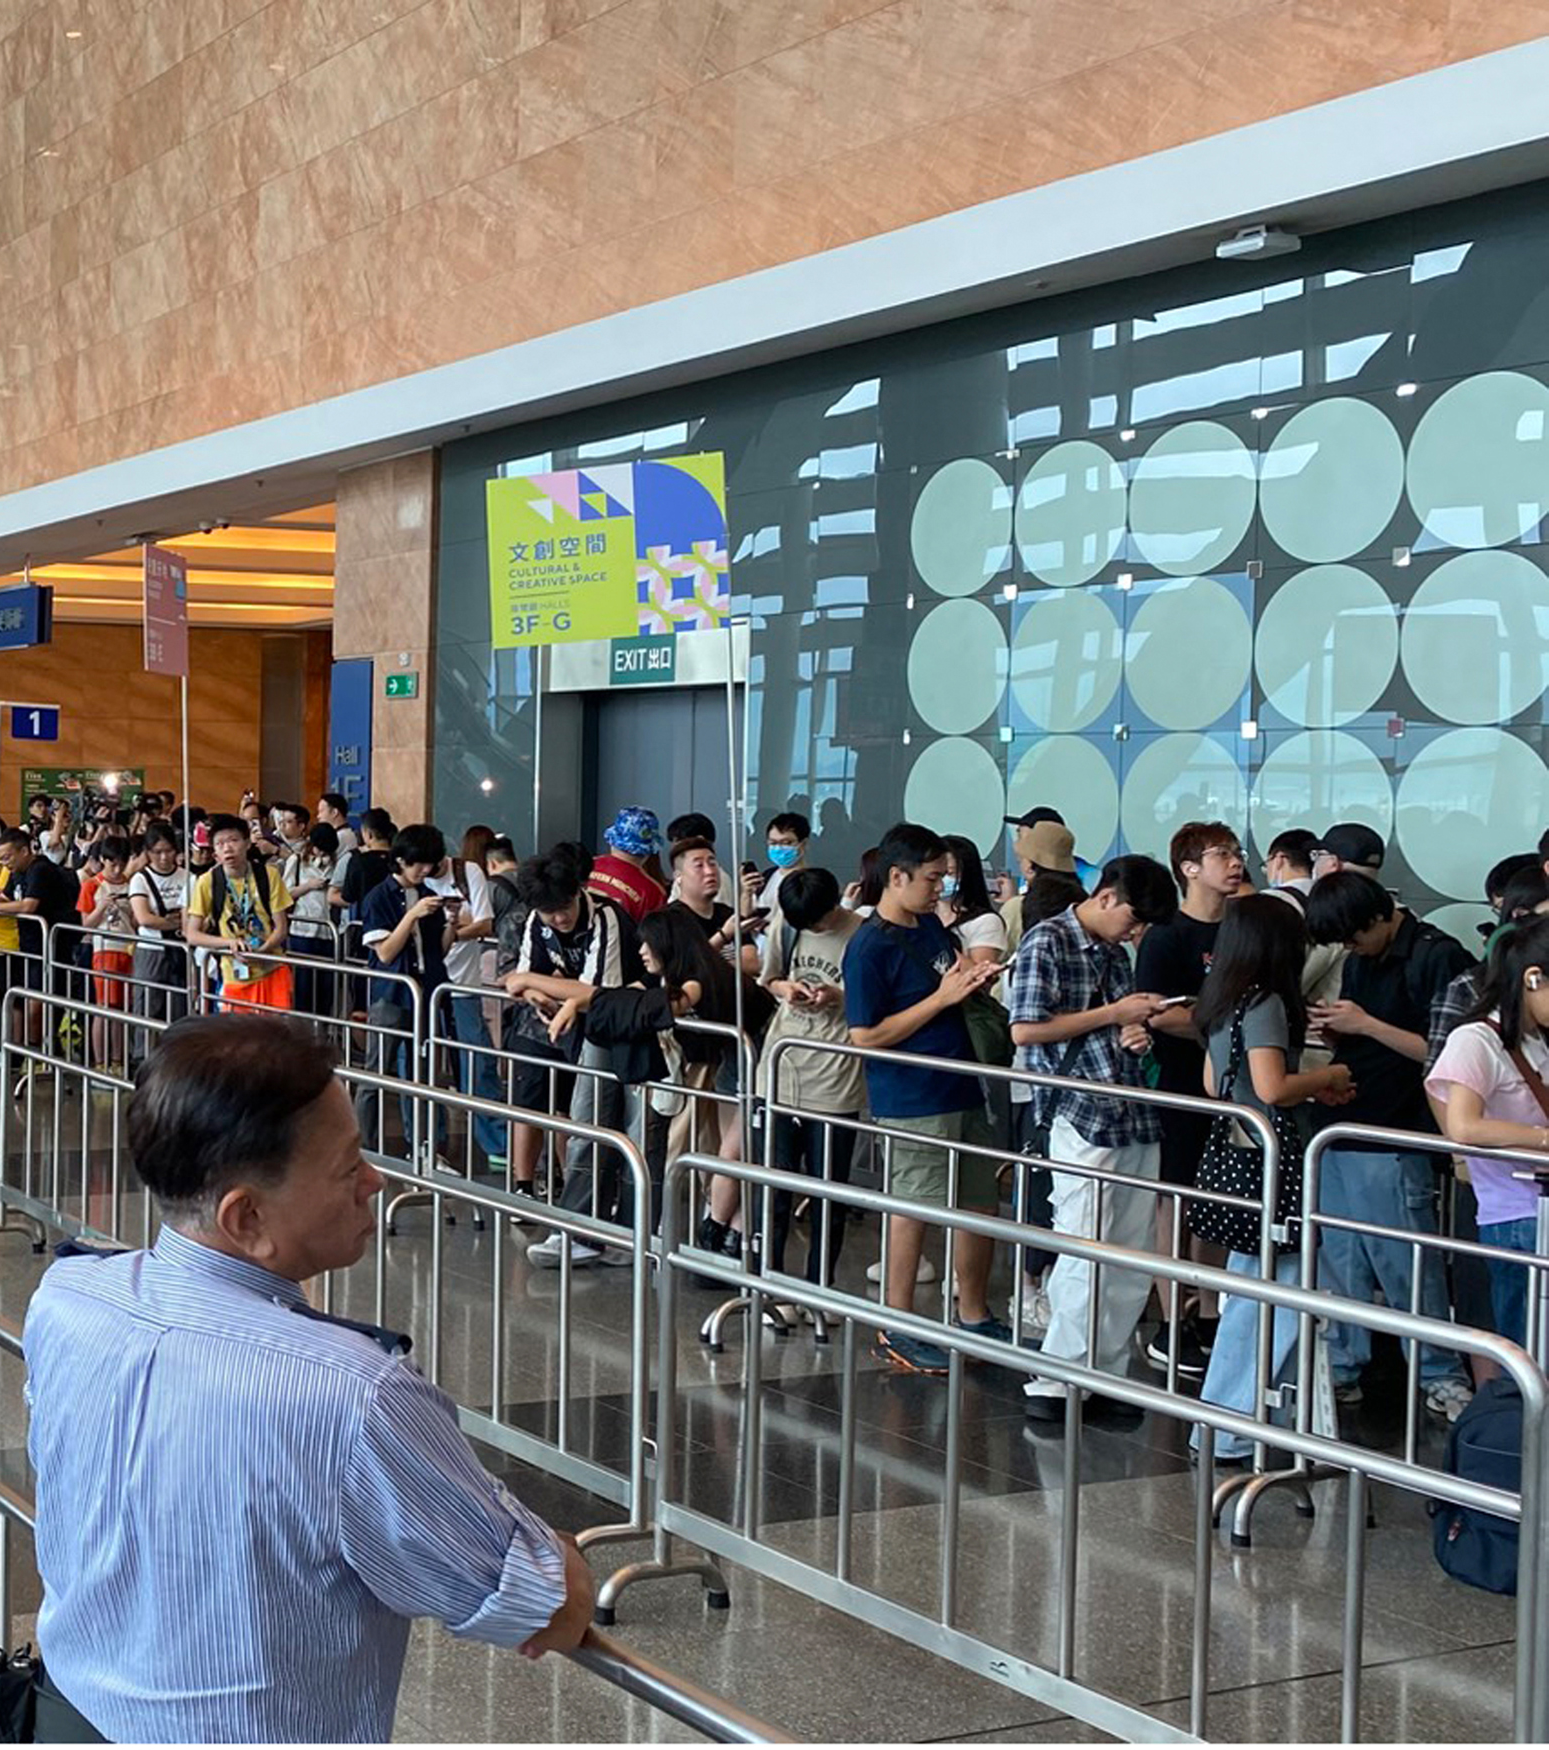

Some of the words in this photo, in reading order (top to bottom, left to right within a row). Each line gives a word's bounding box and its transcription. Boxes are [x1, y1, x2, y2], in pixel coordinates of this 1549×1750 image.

[508, 533, 607, 564] 文創空間
[509, 563, 569, 579] CULTURAL
[572, 562, 581, 572] &
[509, 575, 568, 591] CREATIVE
[569, 571, 608, 586] SPACE
[614, 648, 647, 673] EXIT
[647, 647, 672, 670] 出口
[28, 710, 42, 736] 1
[334, 744, 360, 765] Hall
